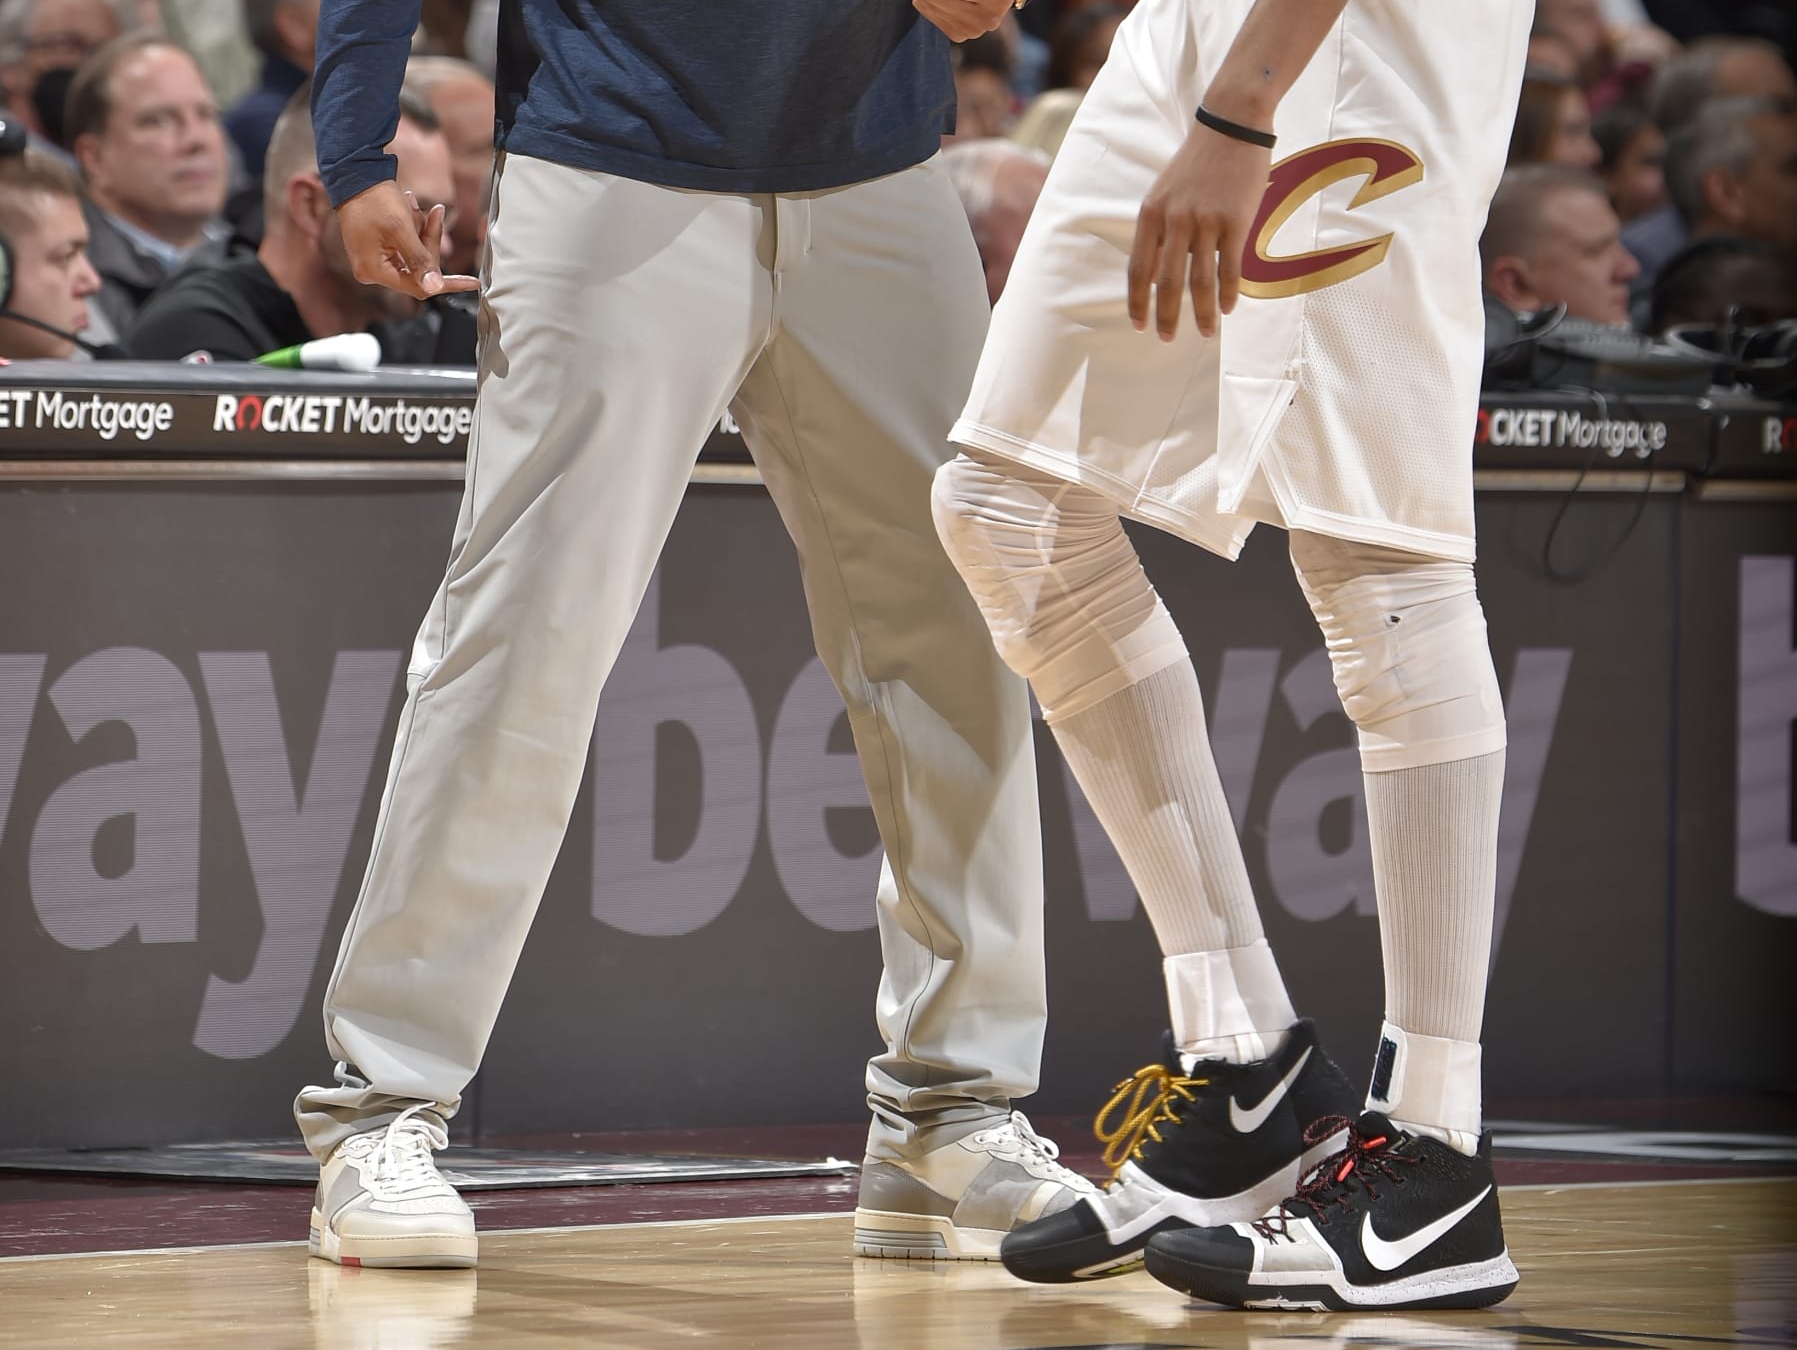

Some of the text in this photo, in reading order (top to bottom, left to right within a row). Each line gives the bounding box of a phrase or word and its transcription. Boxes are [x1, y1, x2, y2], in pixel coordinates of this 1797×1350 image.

[1238, 136, 1425, 300] C
[35, 390, 174, 441] Mortgage
[212, 393, 472, 444] ROCKET Mortgage
[1555, 411, 1668, 458] Mortgage
[0, 646, 402, 1060] ay
